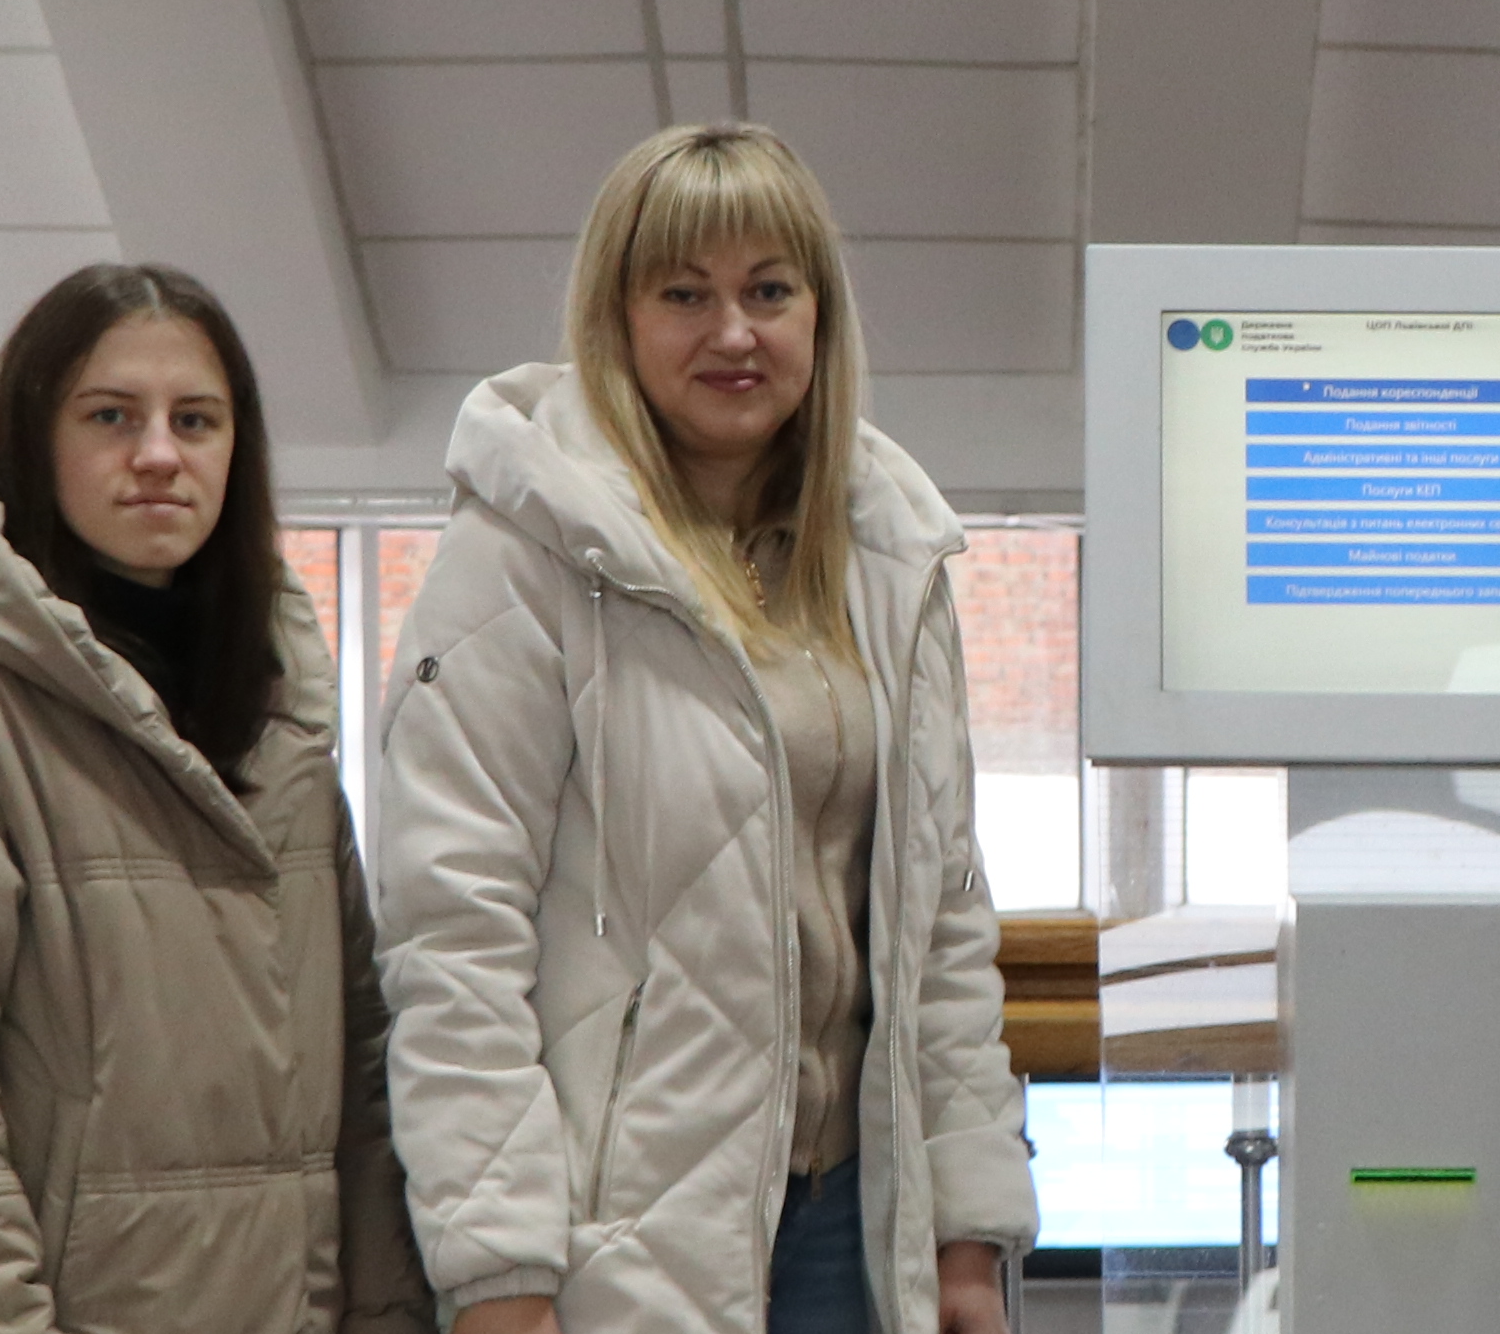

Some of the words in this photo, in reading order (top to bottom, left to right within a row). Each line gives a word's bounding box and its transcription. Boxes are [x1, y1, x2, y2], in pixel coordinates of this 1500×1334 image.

[1323, 386, 1377, 400] Подання
[1346, 419, 1400, 432] Подання
[1451, 454, 1499, 466] послуги
[1362, 484, 1413, 498] Послуги
[1417, 485, 1441, 496] КЕП
